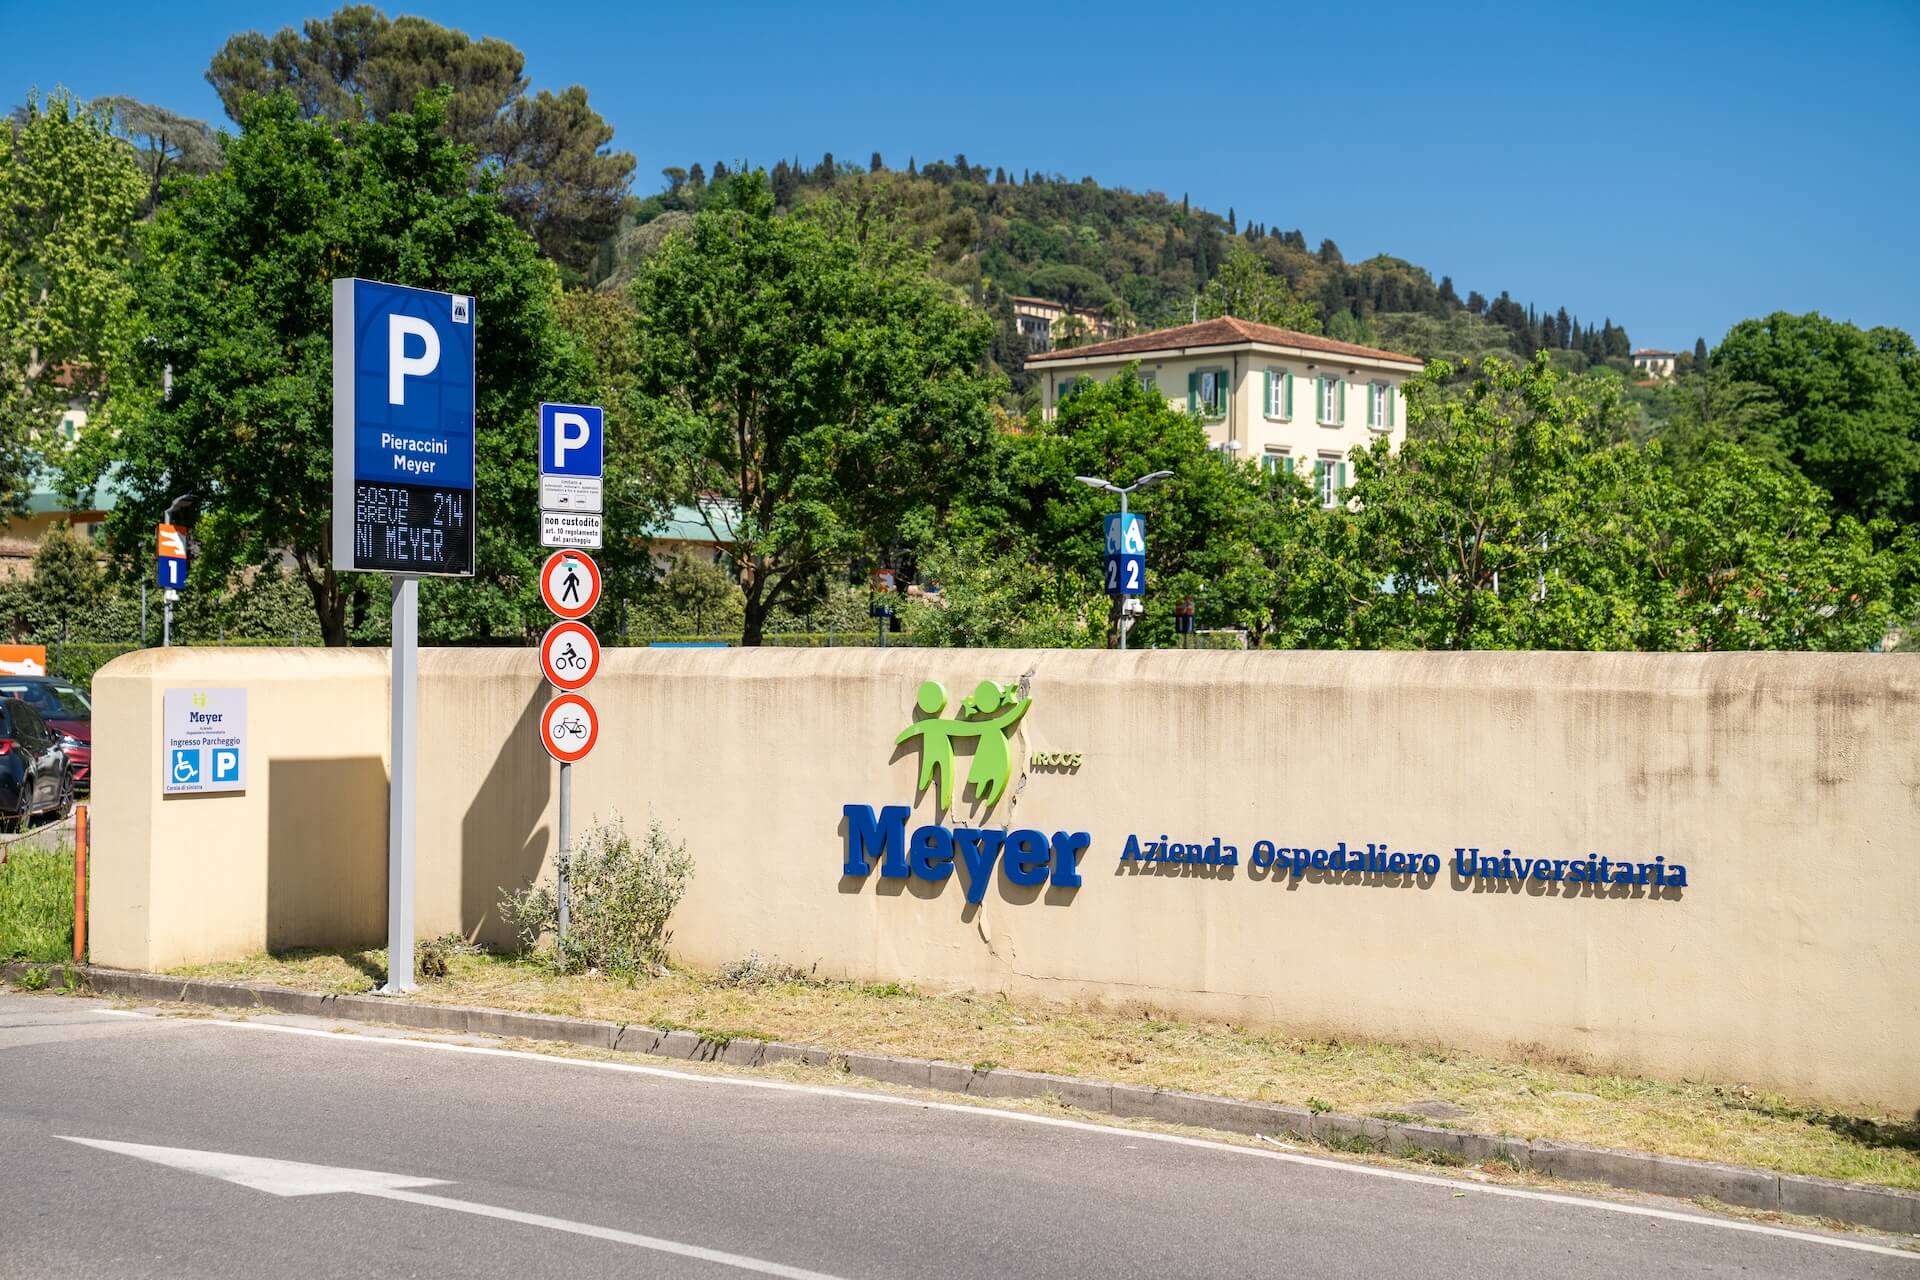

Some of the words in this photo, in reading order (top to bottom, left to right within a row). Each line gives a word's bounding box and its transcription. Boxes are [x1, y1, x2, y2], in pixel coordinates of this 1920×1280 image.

[389, 314, 441, 406] P
[381, 432, 448, 455] Pieraccini
[554, 412, 590, 468] P
[394, 455, 435, 475] Meyer
[357, 486, 409, 507] SOSTA
[357, 504, 409, 526] BREVE
[434, 493, 463, 527] 214
[544, 517, 559, 525] non
[561, 517, 599, 527] custodito
[357, 523, 373, 558] NI
[386, 525, 444, 562] MEYER
[565, 529, 598, 537] regolamento
[168, 560, 177, 584] 1
[1108, 560, 1117, 589] 2
[1126, 560, 1139, 590] 2
[190, 711, 223, 725] Meyer
[170, 738, 201, 748] Ingresso
[202, 737, 241, 747] Parcheggio
[217, 752, 236, 778] P
[1031, 751, 1083, 768] IRCCS
[843, 803, 1091, 905] Meyer
[1120, 833, 1239, 866] Azienda
[1251, 839, 1441, 877] Ospedaliero
[1454, 847, 1688, 888] Universitaria
